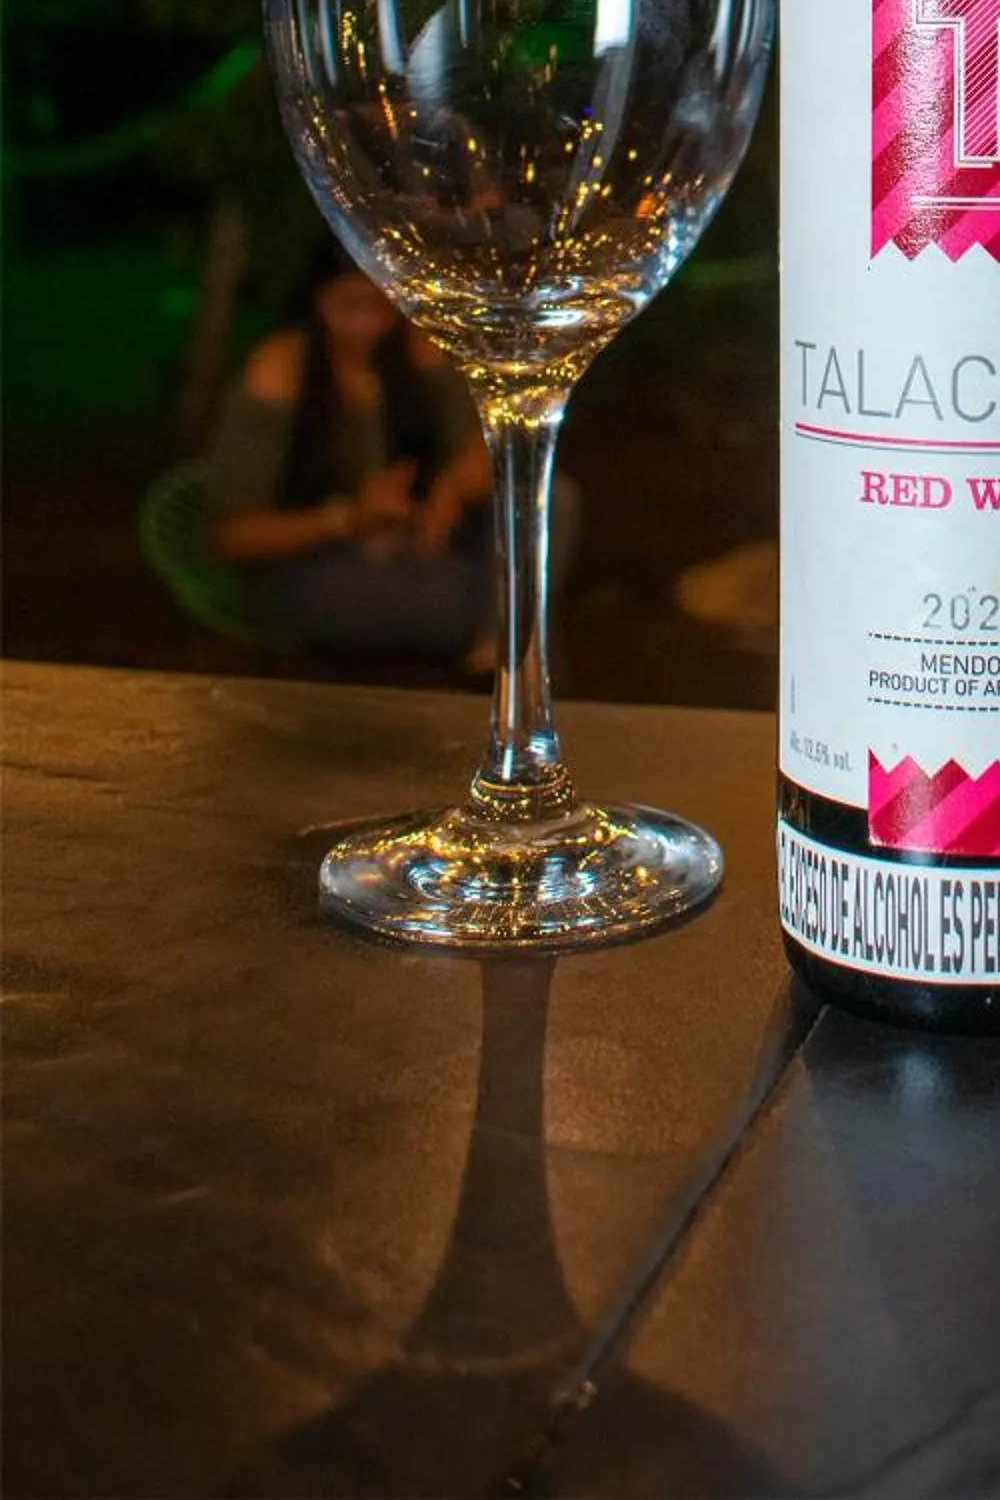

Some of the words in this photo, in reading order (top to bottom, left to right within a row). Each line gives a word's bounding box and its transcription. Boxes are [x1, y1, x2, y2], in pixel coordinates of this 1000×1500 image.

[859, 470, 953, 509] RED
[868, 669, 950, 695] PRODUCT
[954, 678, 980, 697] OF
[830, 859, 850, 955] DE
[852, 866, 935, 974] ALCOHOL
[940, 880, 965, 974] ES
